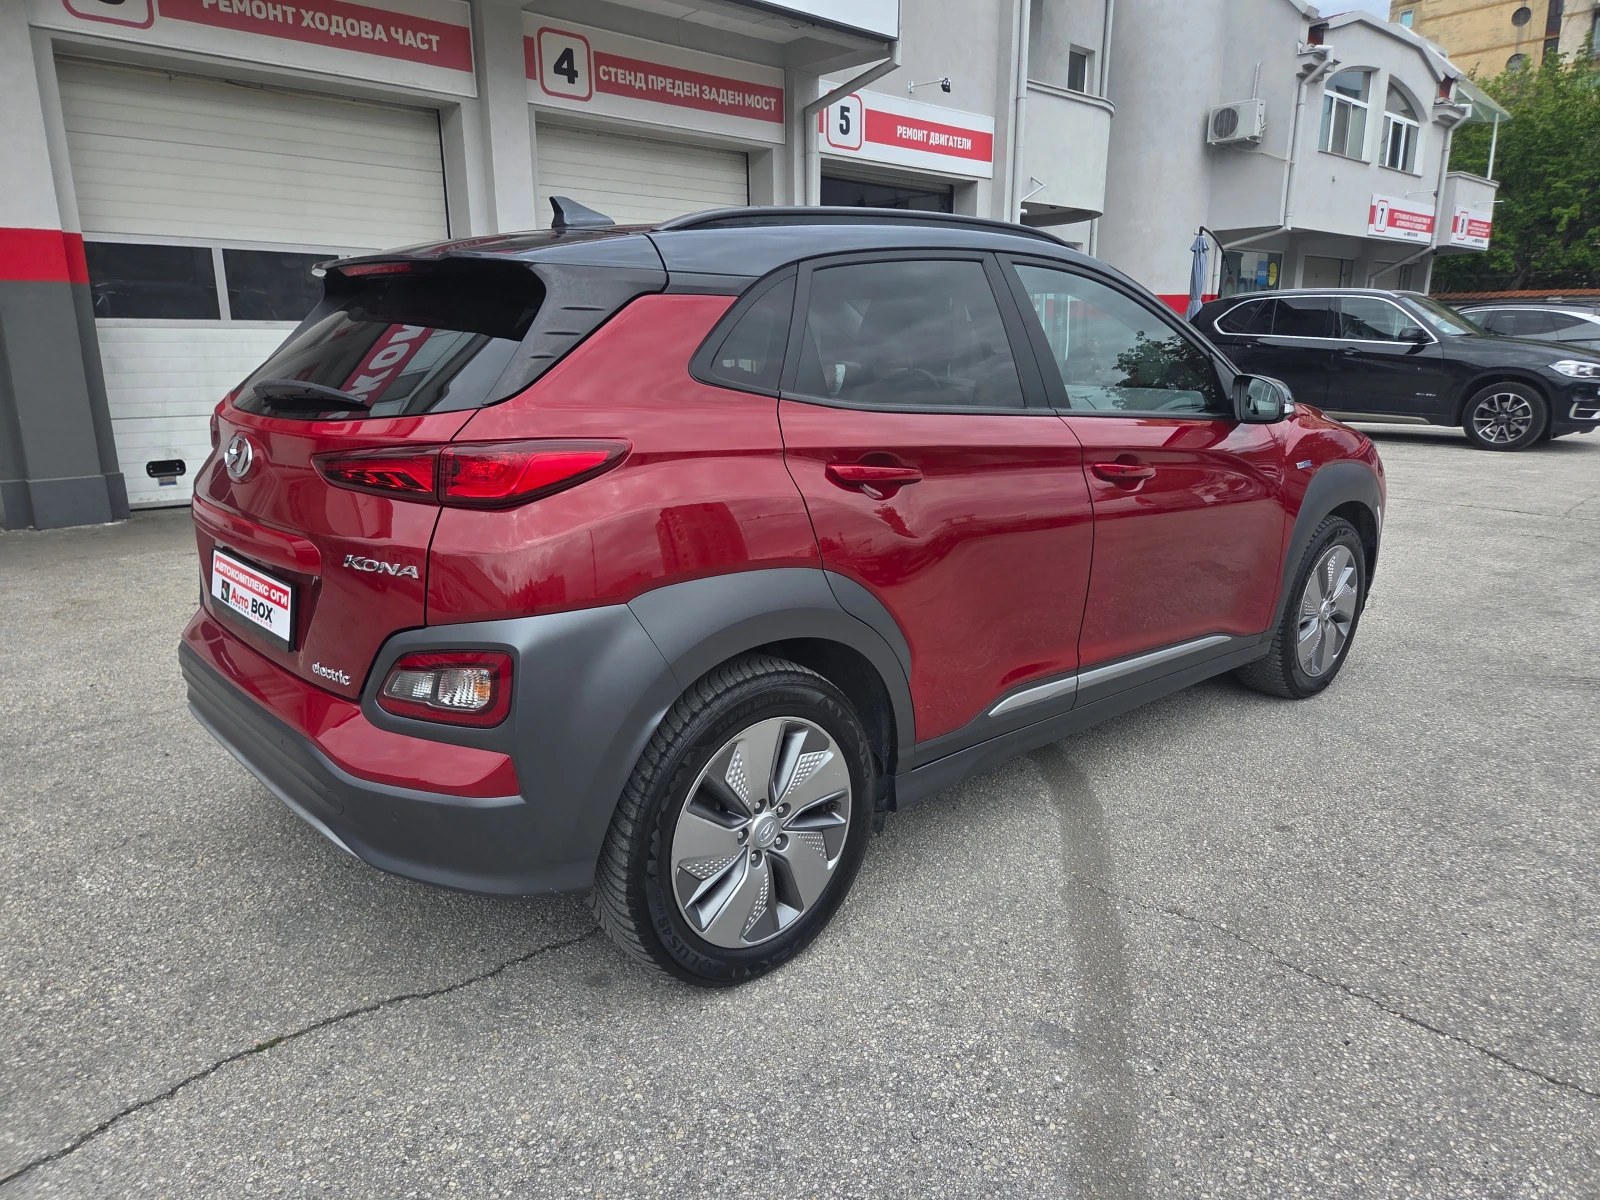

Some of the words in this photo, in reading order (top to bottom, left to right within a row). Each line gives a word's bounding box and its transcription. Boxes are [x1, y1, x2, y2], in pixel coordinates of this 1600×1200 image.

[300, 10, 388, 42] ХОДОВА
[390, 28, 440, 52] ЧАСТ
[553, 47, 579, 85] 4
[599, 65, 646, 90] СТЕНД
[648, 75, 700, 98] ПРЕДЕН
[701, 85, 743, 106] ЗАДЕН
[745, 94, 777, 111] МОСТ
[839, 105, 851, 135] 5
[896, 125, 928, 143] РЕМОНТ
[928, 131, 972, 151] ДВИГАТЕЛИ
[1379, 207, 1385, 225] 7
[343, 554, 419, 579] KONA
[215, 560, 269, 597] АВТОКОМПЛЕКС
[270, 587, 288, 605] ОГИ
[251, 598, 273, 624] BOX
[312, 661, 351, 686] electric
